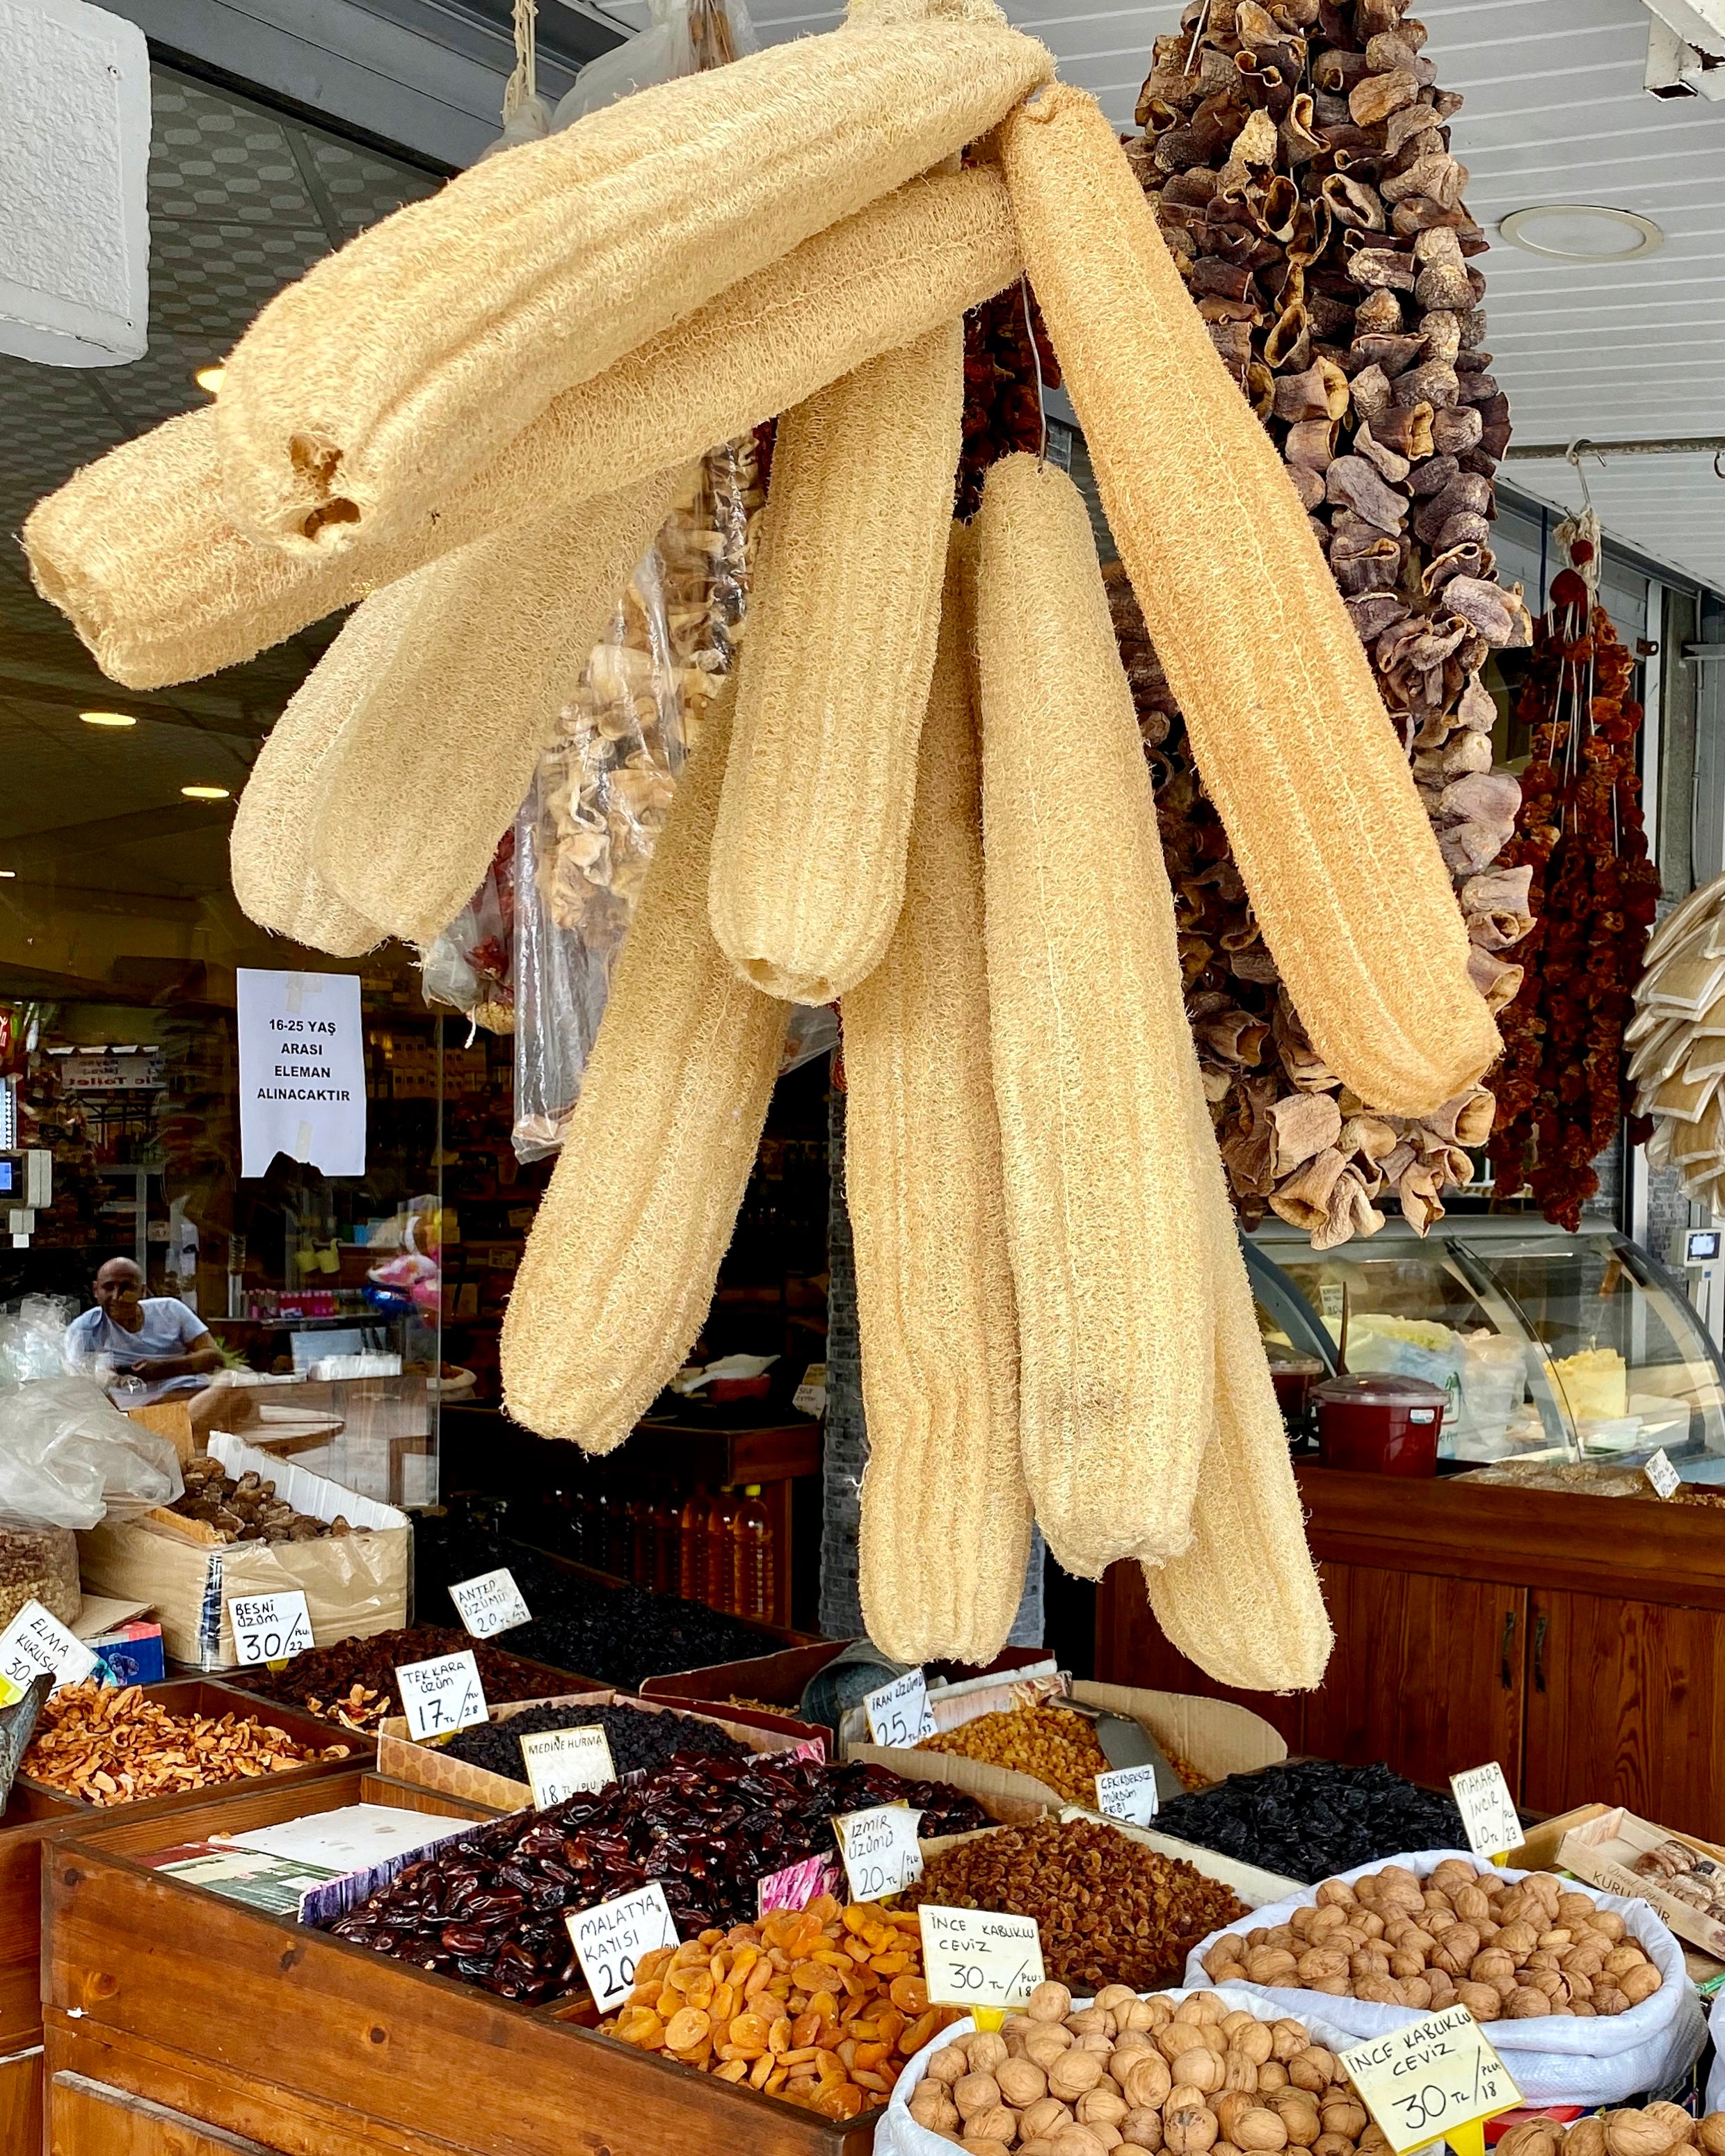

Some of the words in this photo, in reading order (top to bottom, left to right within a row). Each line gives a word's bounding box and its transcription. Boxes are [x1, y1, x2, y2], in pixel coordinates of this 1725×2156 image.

[269, 1019, 304, 1032] 16-25
[308, 1020, 337, 1036] YAŞ
[281, 1043, 323, 1055] ARASI
[274, 1065, 330, 1078] ELEMAN
[257, 1088, 351, 1102] ALINACAKTIR
[459, 1579, 495, 1603] ANTEP
[236, 1600, 273, 1616] BESNİ
[477, 1613, 497, 1632] 20
[30, 1618, 69, 1657] ELMA
[243, 1633, 281, 1661] 30
[289, 1641, 304, 1651] 22
[6, 1657, 31, 1680] 30
[403, 1670, 431, 1684] TEK
[432, 1662, 466, 1677] KARA
[419, 1698, 444, 1731] 17
[464, 1705, 479, 1717] 28
[877, 1711, 907, 1746] 25
[568, 1735, 603, 1749] HURMA
[542, 1785, 559, 1805] 18
[562, 1786, 572, 1794] TL
[851, 1815, 892, 1838] İZMİR
[1505, 1826, 1517, 1842] 23
[860, 1866, 884, 1895] 20
[886, 1876, 898, 1885] TL
[1608, 1863, 1639, 1886] Dried
[580, 1894, 655, 1940] MALATYA
[931, 1913, 967, 1931] İNCE
[982, 1924, 1035, 1938] KABUKLU
[584, 1929, 639, 1963] KAYISI
[940, 1938, 993, 1953] CEVİZ
[599, 1955, 635, 1997] 20
[949, 1963, 984, 1989] 30
[988, 1980, 1004, 1990] TL
[1018, 1986, 1032, 1997] 18
[1347, 2042, 1393, 2074] İNCE
[1403, 2012, 1472, 2049] KABUKLU
[1393, 2043, 1457, 2077] CEVİZ
[1482, 2081, 1497, 2100] 18
[1392, 2084, 1447, 2129] 30
[1450, 2091, 1470, 2104] TL
